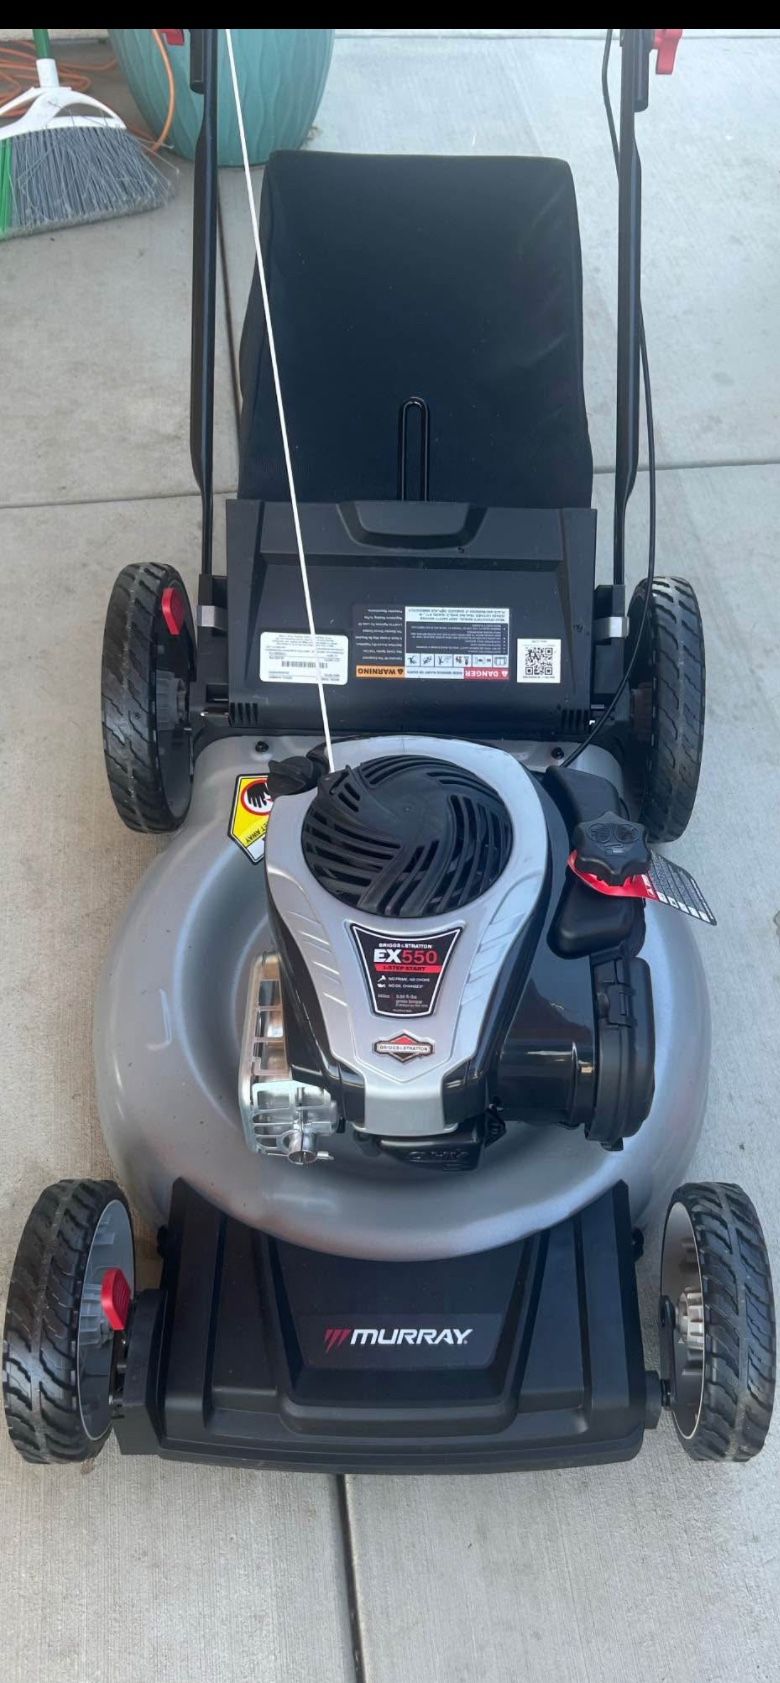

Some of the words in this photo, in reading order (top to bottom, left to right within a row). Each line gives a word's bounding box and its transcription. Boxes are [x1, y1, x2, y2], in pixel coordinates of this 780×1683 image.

[245, 828, 261, 842] AWAY
[374, 949, 437, 963] EX550
[350, 1328, 473, 1345] MURRAY
